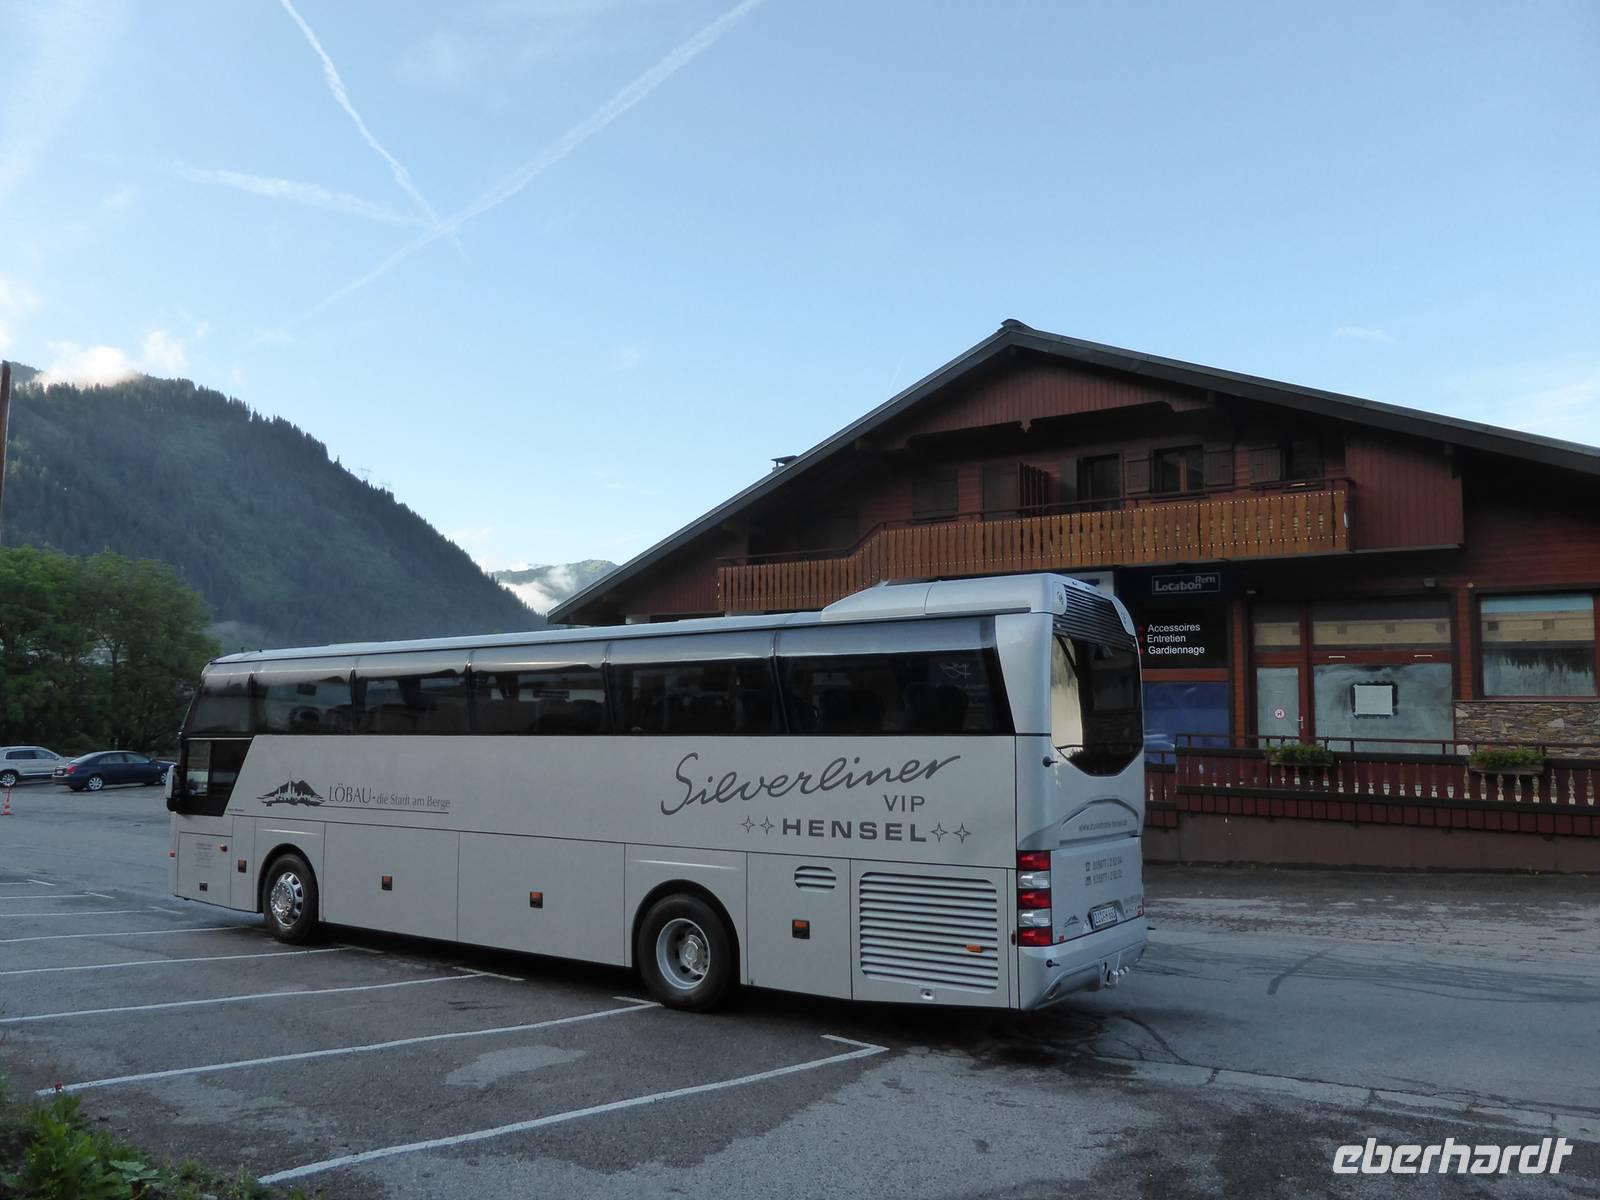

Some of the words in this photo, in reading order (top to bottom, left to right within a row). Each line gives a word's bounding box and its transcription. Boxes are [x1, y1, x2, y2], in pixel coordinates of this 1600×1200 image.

[1155, 580, 1201, 591] Location
[1147, 623, 1201, 632] Accessoires
[1147, 634, 1186, 643] Entretien
[1148, 645, 1205, 655] Gardiennage
[660, 751, 961, 815] Silverliner
[377, 794, 388, 805] die
[390, 794, 410, 807] Stadt
[412, 799, 425, 807] am
[427, 796, 451, 809] Berge
[883, 794, 925, 812] VIP
[782, 817, 927, 842] HENSEL
